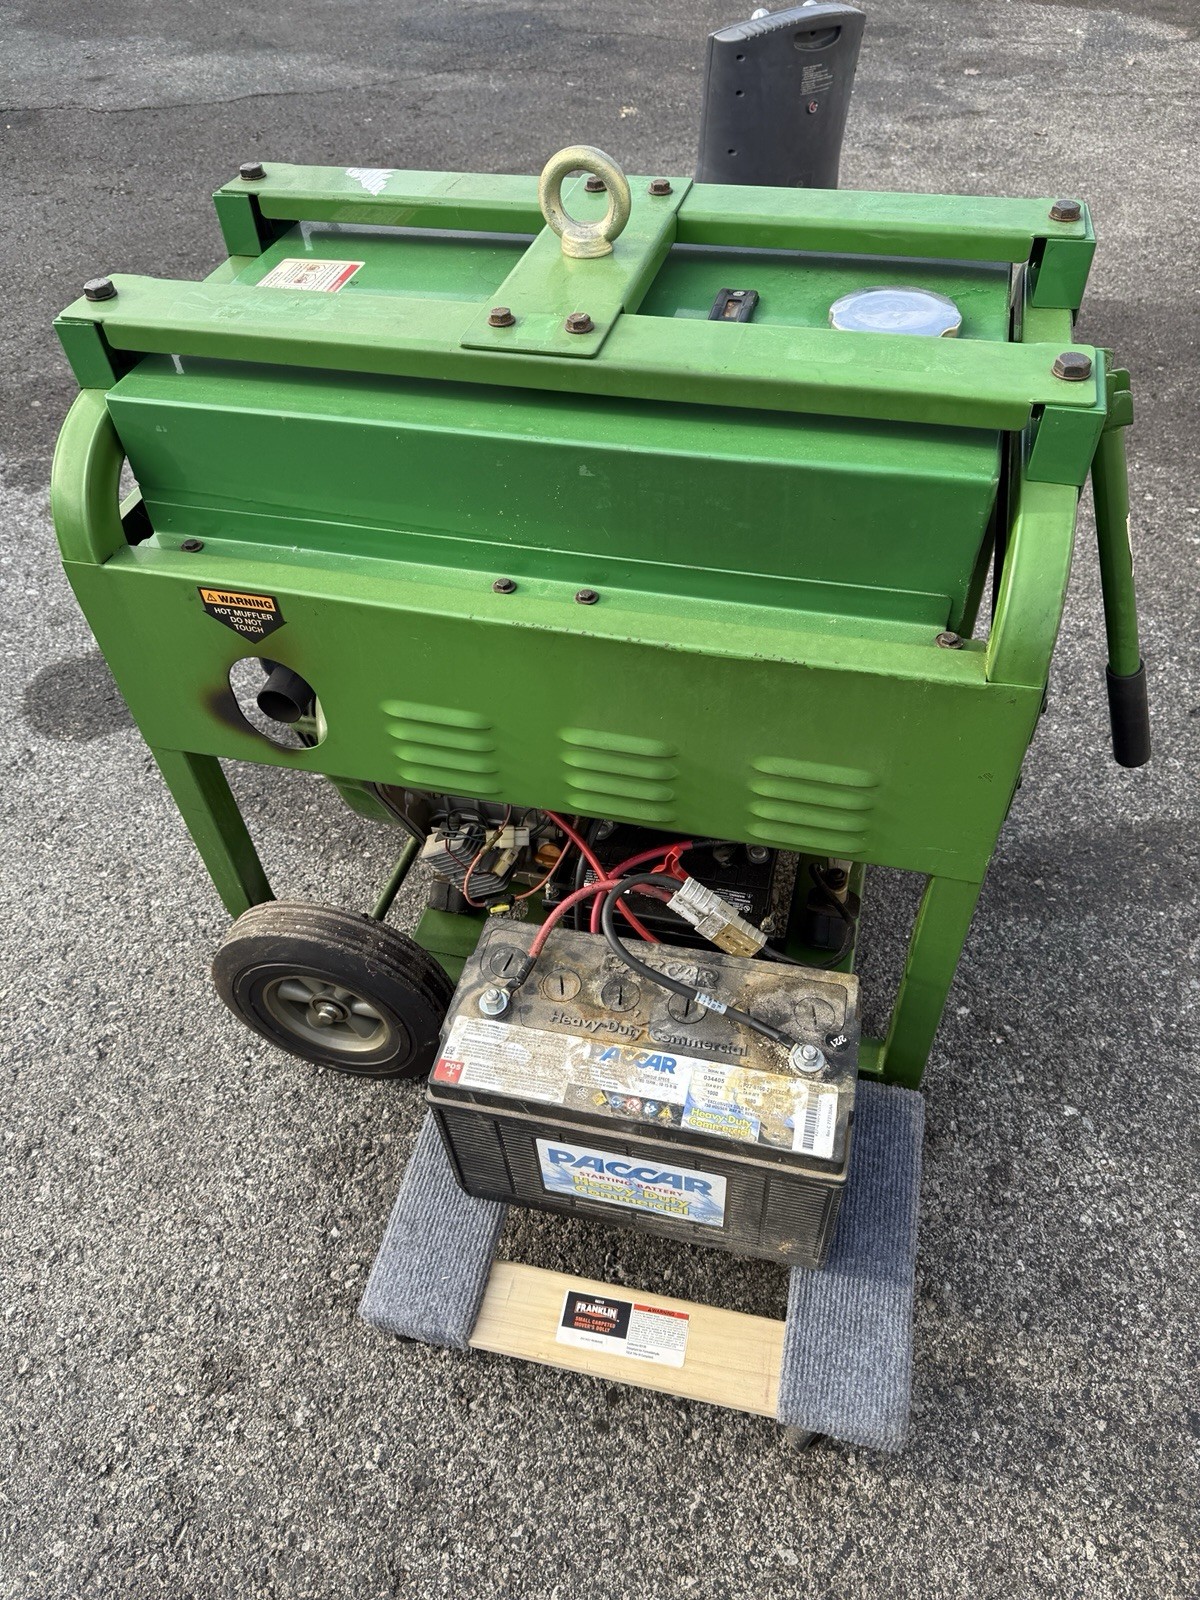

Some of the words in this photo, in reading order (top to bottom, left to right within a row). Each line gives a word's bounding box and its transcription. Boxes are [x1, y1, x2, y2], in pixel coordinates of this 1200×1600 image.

[217, 594, 273, 609] WARNING
[213, 607, 231, 615] HOT
[233, 609, 274, 621] MUFFLER
[230, 616, 243, 624] DO
[234, 623, 264, 633] TOUCH
[550, 1010, 645, 1041] Heavy-Duty
[649, 1026, 748, 1057] Commercial
[444, 1062, 461, 1071] POS
[589, 1044, 677, 1075] PACCAR
[703, 1075, 725, 1084] 034405
[690, 1107, 753, 1129] Heavy-Duty
[688, 1117, 751, 1137] Commercial
[547, 1148, 713, 1197] PACCAR
[572, 1175, 692, 1208] Heavy-Duty
[579, 1171, 633, 1186] STARTING
[637, 1183, 684, 1197] BATTERY
[574, 1184, 690, 1216] Commercial
[576, 1302, 618, 1319] FRANKLIN
[573, 1321, 595, 1330] MOVER'S
[595, 1325, 611, 1333] DOLLY
[574, 1316, 591, 1324] SMALL
[591, 1319, 616, 1329] CARPETED
